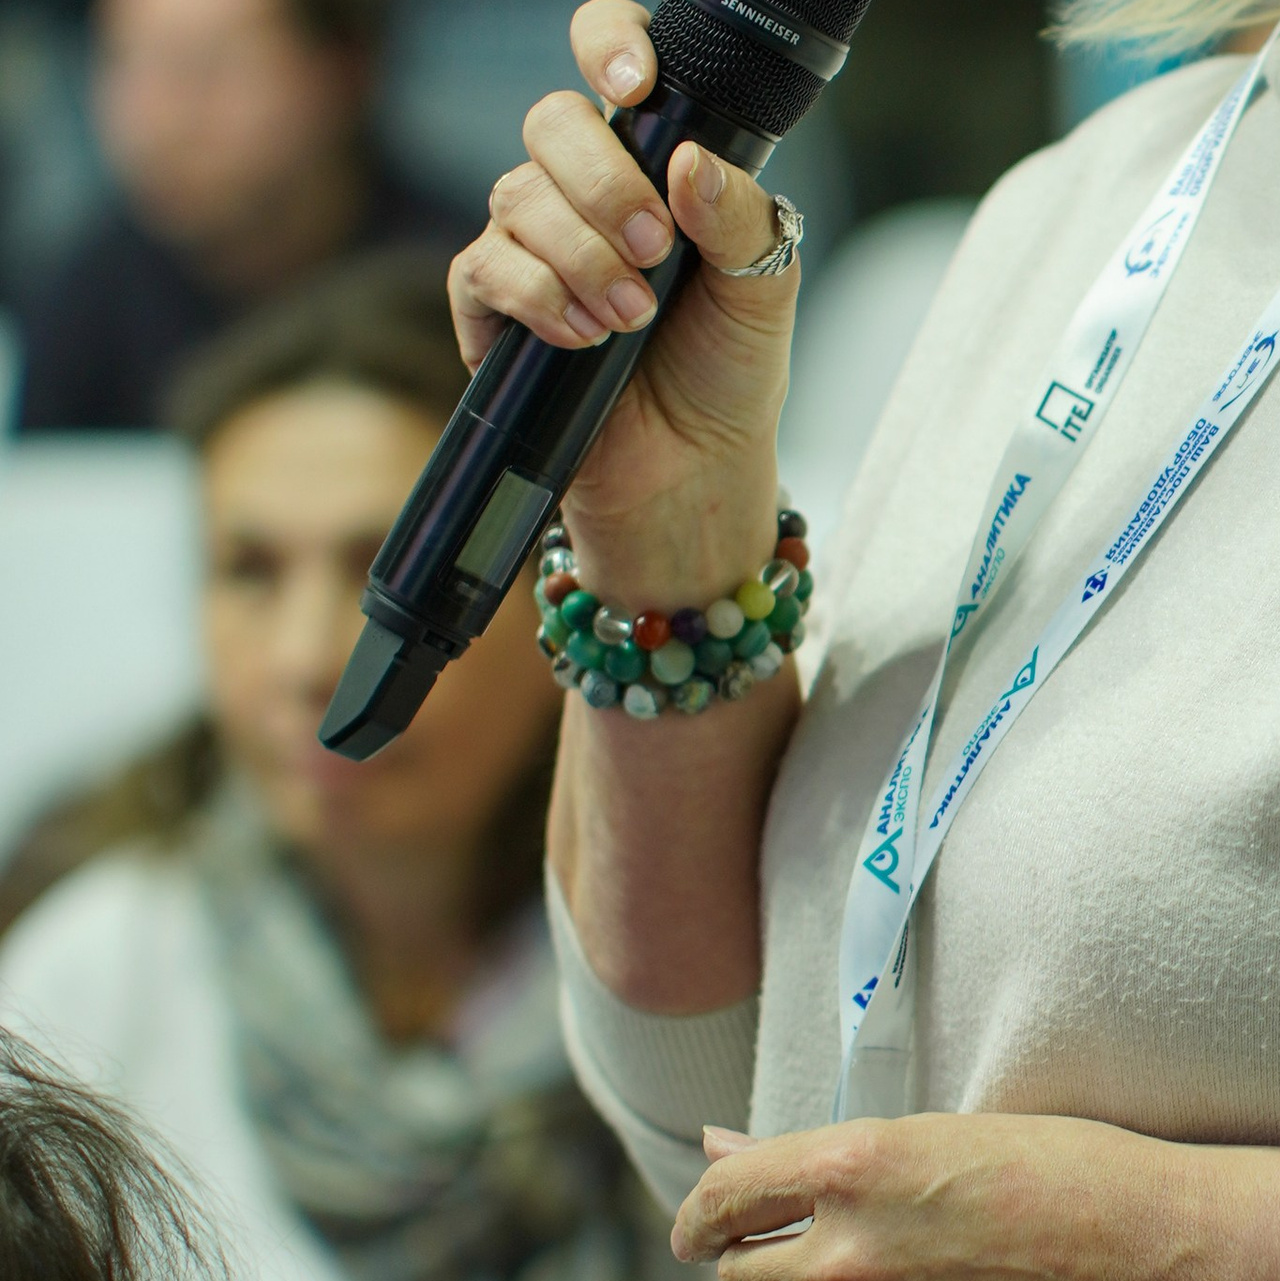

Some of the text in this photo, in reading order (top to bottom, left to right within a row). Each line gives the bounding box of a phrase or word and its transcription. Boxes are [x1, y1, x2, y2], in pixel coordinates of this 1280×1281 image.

[971, 473, 1032, 600] АНАЛИТИКА
[1104, 417, 1208, 561] ОБОРУДОВАНИЯ
[1117, 424, 1220, 566] ВАШ ПОСТАВЩИК
[894, 765, 912, 823] ЭКСПО
[928, 698, 1011, 829] АНАЛИТИКА
[962, 704, 1000, 757] ЭКСПО
